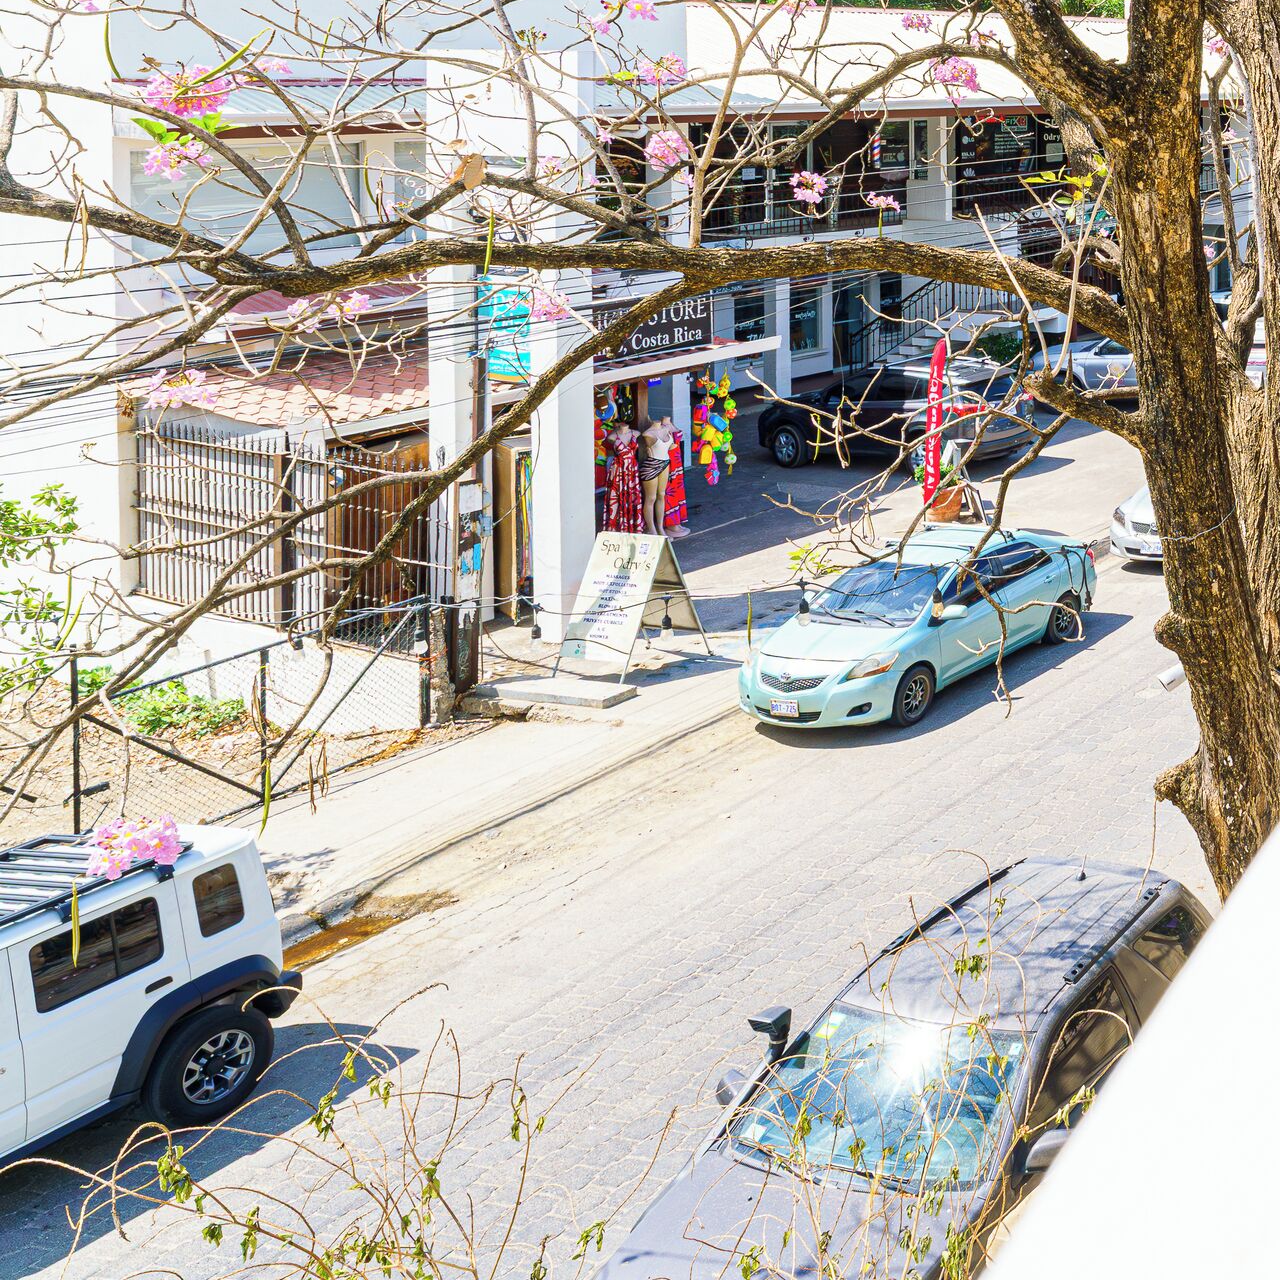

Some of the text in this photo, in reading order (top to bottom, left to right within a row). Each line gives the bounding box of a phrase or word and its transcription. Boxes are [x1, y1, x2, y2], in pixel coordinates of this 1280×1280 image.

[1043, 132, 1061, 142] Odry
[648, 297, 707, 326] STORE
[631, 332, 670, 351] Costa
[673, 326, 703, 345] Rica
[601, 539, 621, 556] Spa
